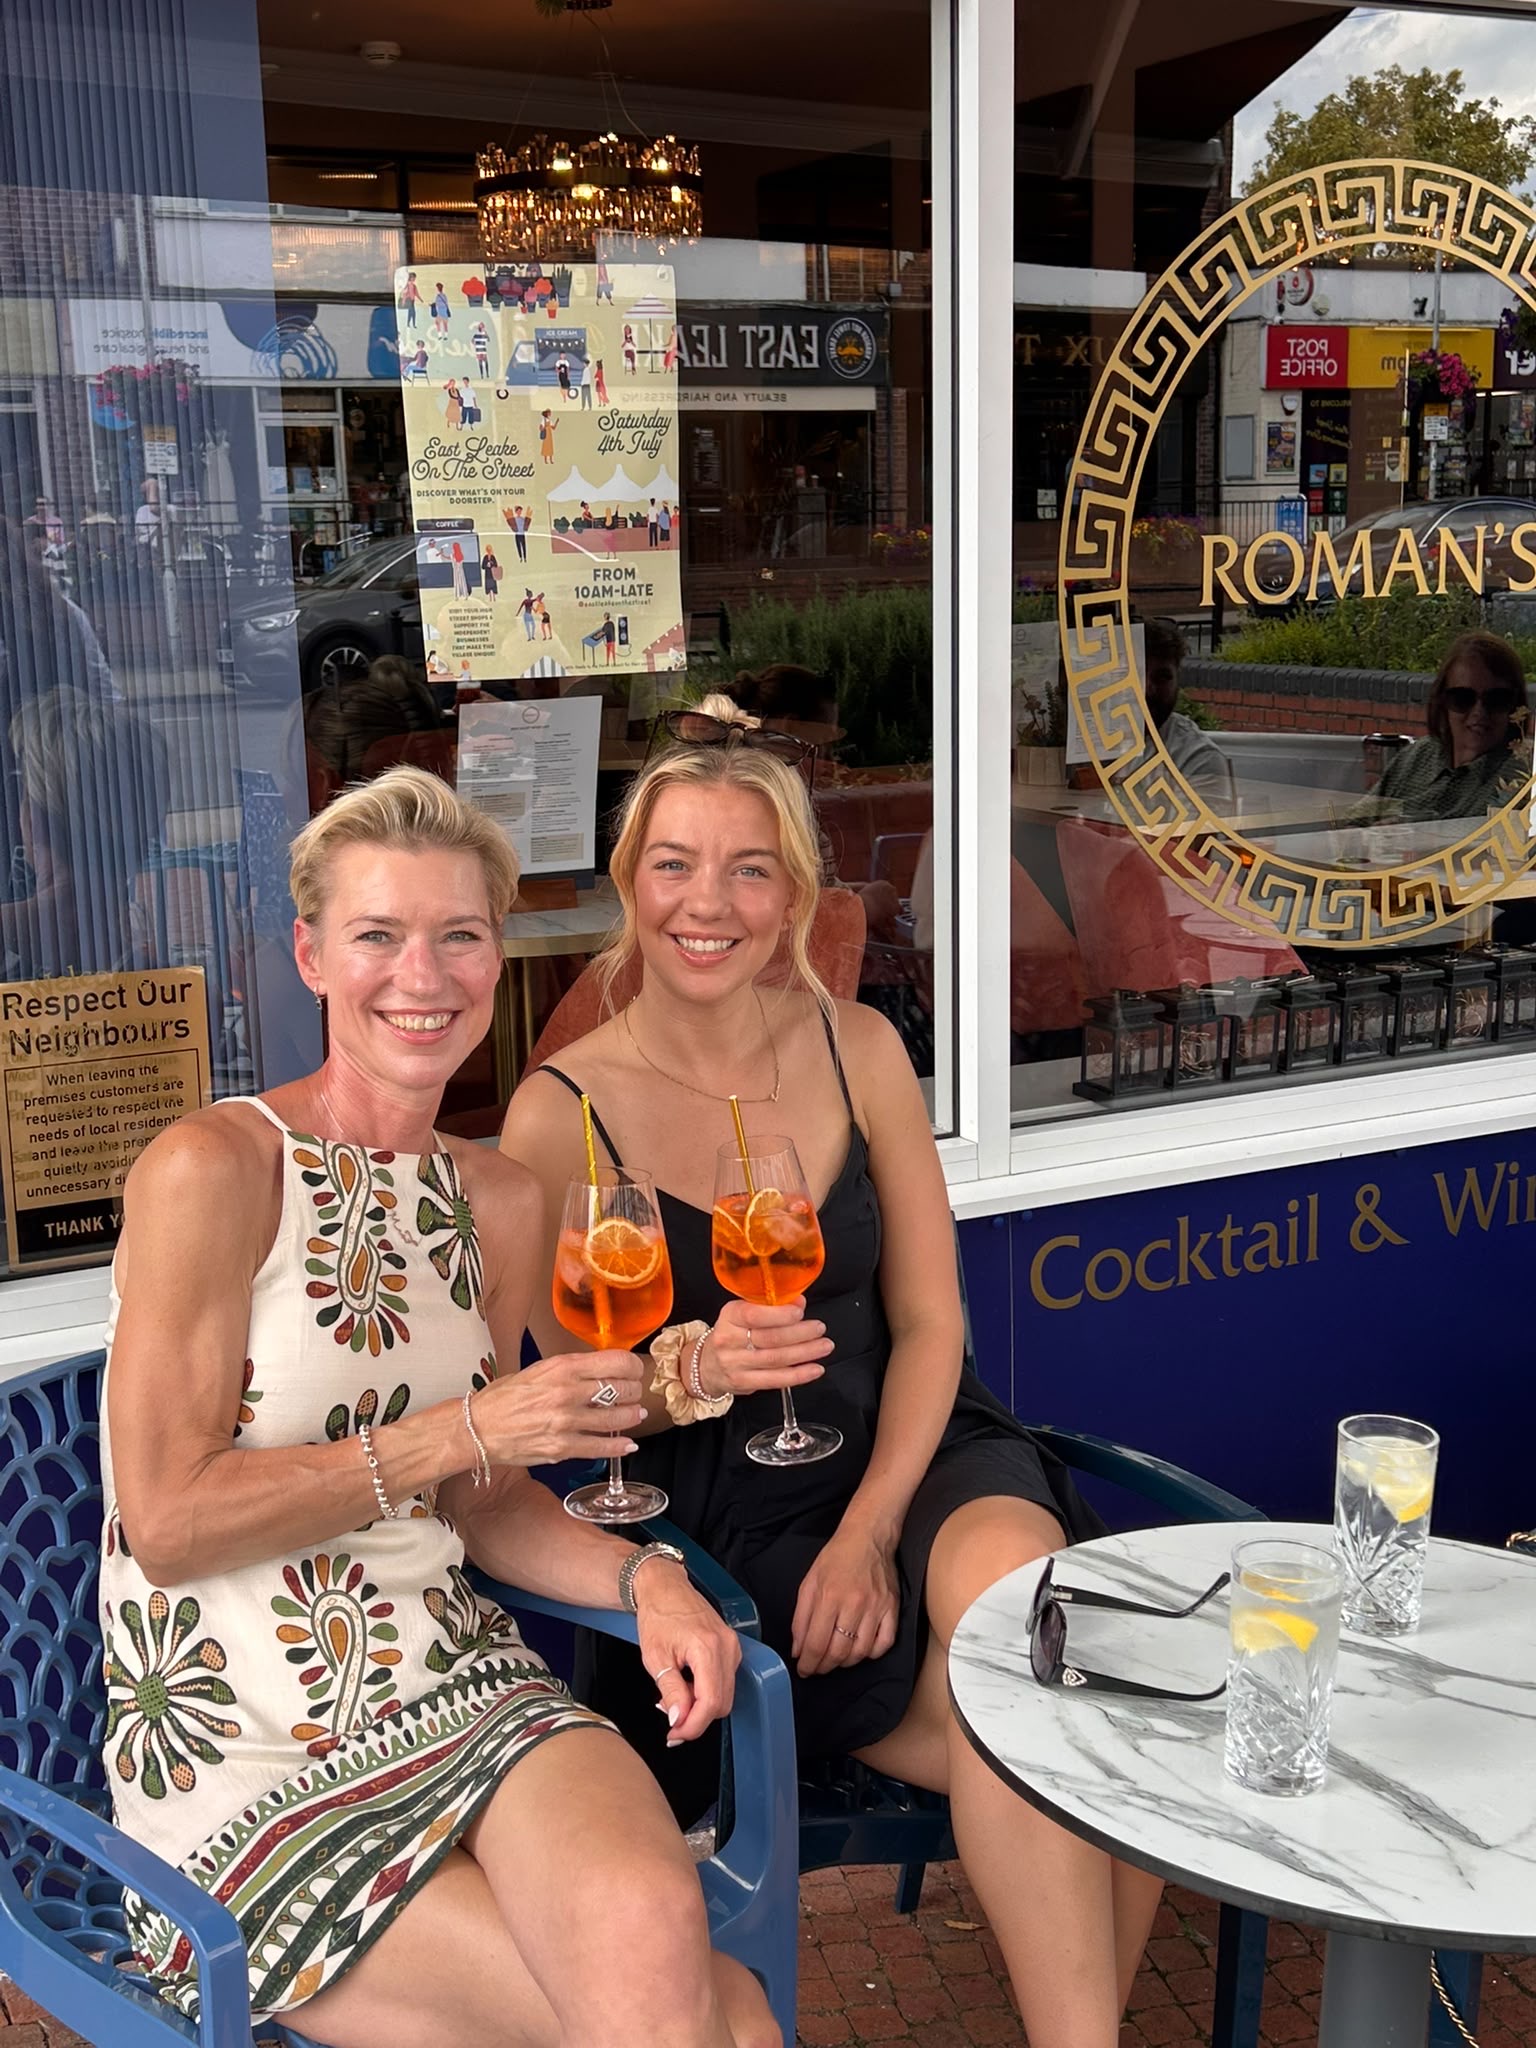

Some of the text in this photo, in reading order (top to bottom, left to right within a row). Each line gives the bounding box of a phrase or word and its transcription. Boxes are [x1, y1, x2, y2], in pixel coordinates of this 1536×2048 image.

[597, 408, 672, 437] Saturday
[424, 436, 520, 464] East Leake
[597, 430, 663, 459] 4th July
[411, 458, 535, 481] On The Street
[416, 488, 526, 498] DISCOVER WHAT'S ON YOUR
[449, 497, 495, 505] DOORSTEP.
[435, 520, 460, 529] COFFEE
[592, 567, 637, 582] FROM
[1199, 522, 1536, 607] ROMAN'S
[574, 583, 654, 600] 10AM-LATE
[2, 979, 193, 1021] Respect Our
[8, 1018, 191, 1057] Neighbours
[46, 1073, 84, 1087] When
[88, 1066, 136, 1083] leaving
[138, 1064, 159, 1076] the
[24, 1079, 184, 1111] premises customers are
[25, 1097, 184, 1127] requested to respect the
[28, 1128, 70, 1144] needs
[73, 1124, 87, 1138] of
[89, 1120, 121, 1136] local
[31, 1147, 57, 1162] and
[60, 1143, 96, 1158] leave
[98, 1140, 119, 1153] the
[43, 1160, 88, 1180] quietly
[26, 1179, 111, 1198] unnecessary
[44, 1216, 105, 1239] THANK
[1029, 1193, 1320, 1310] Cocktail
[1348, 1182, 1411, 1254] &
